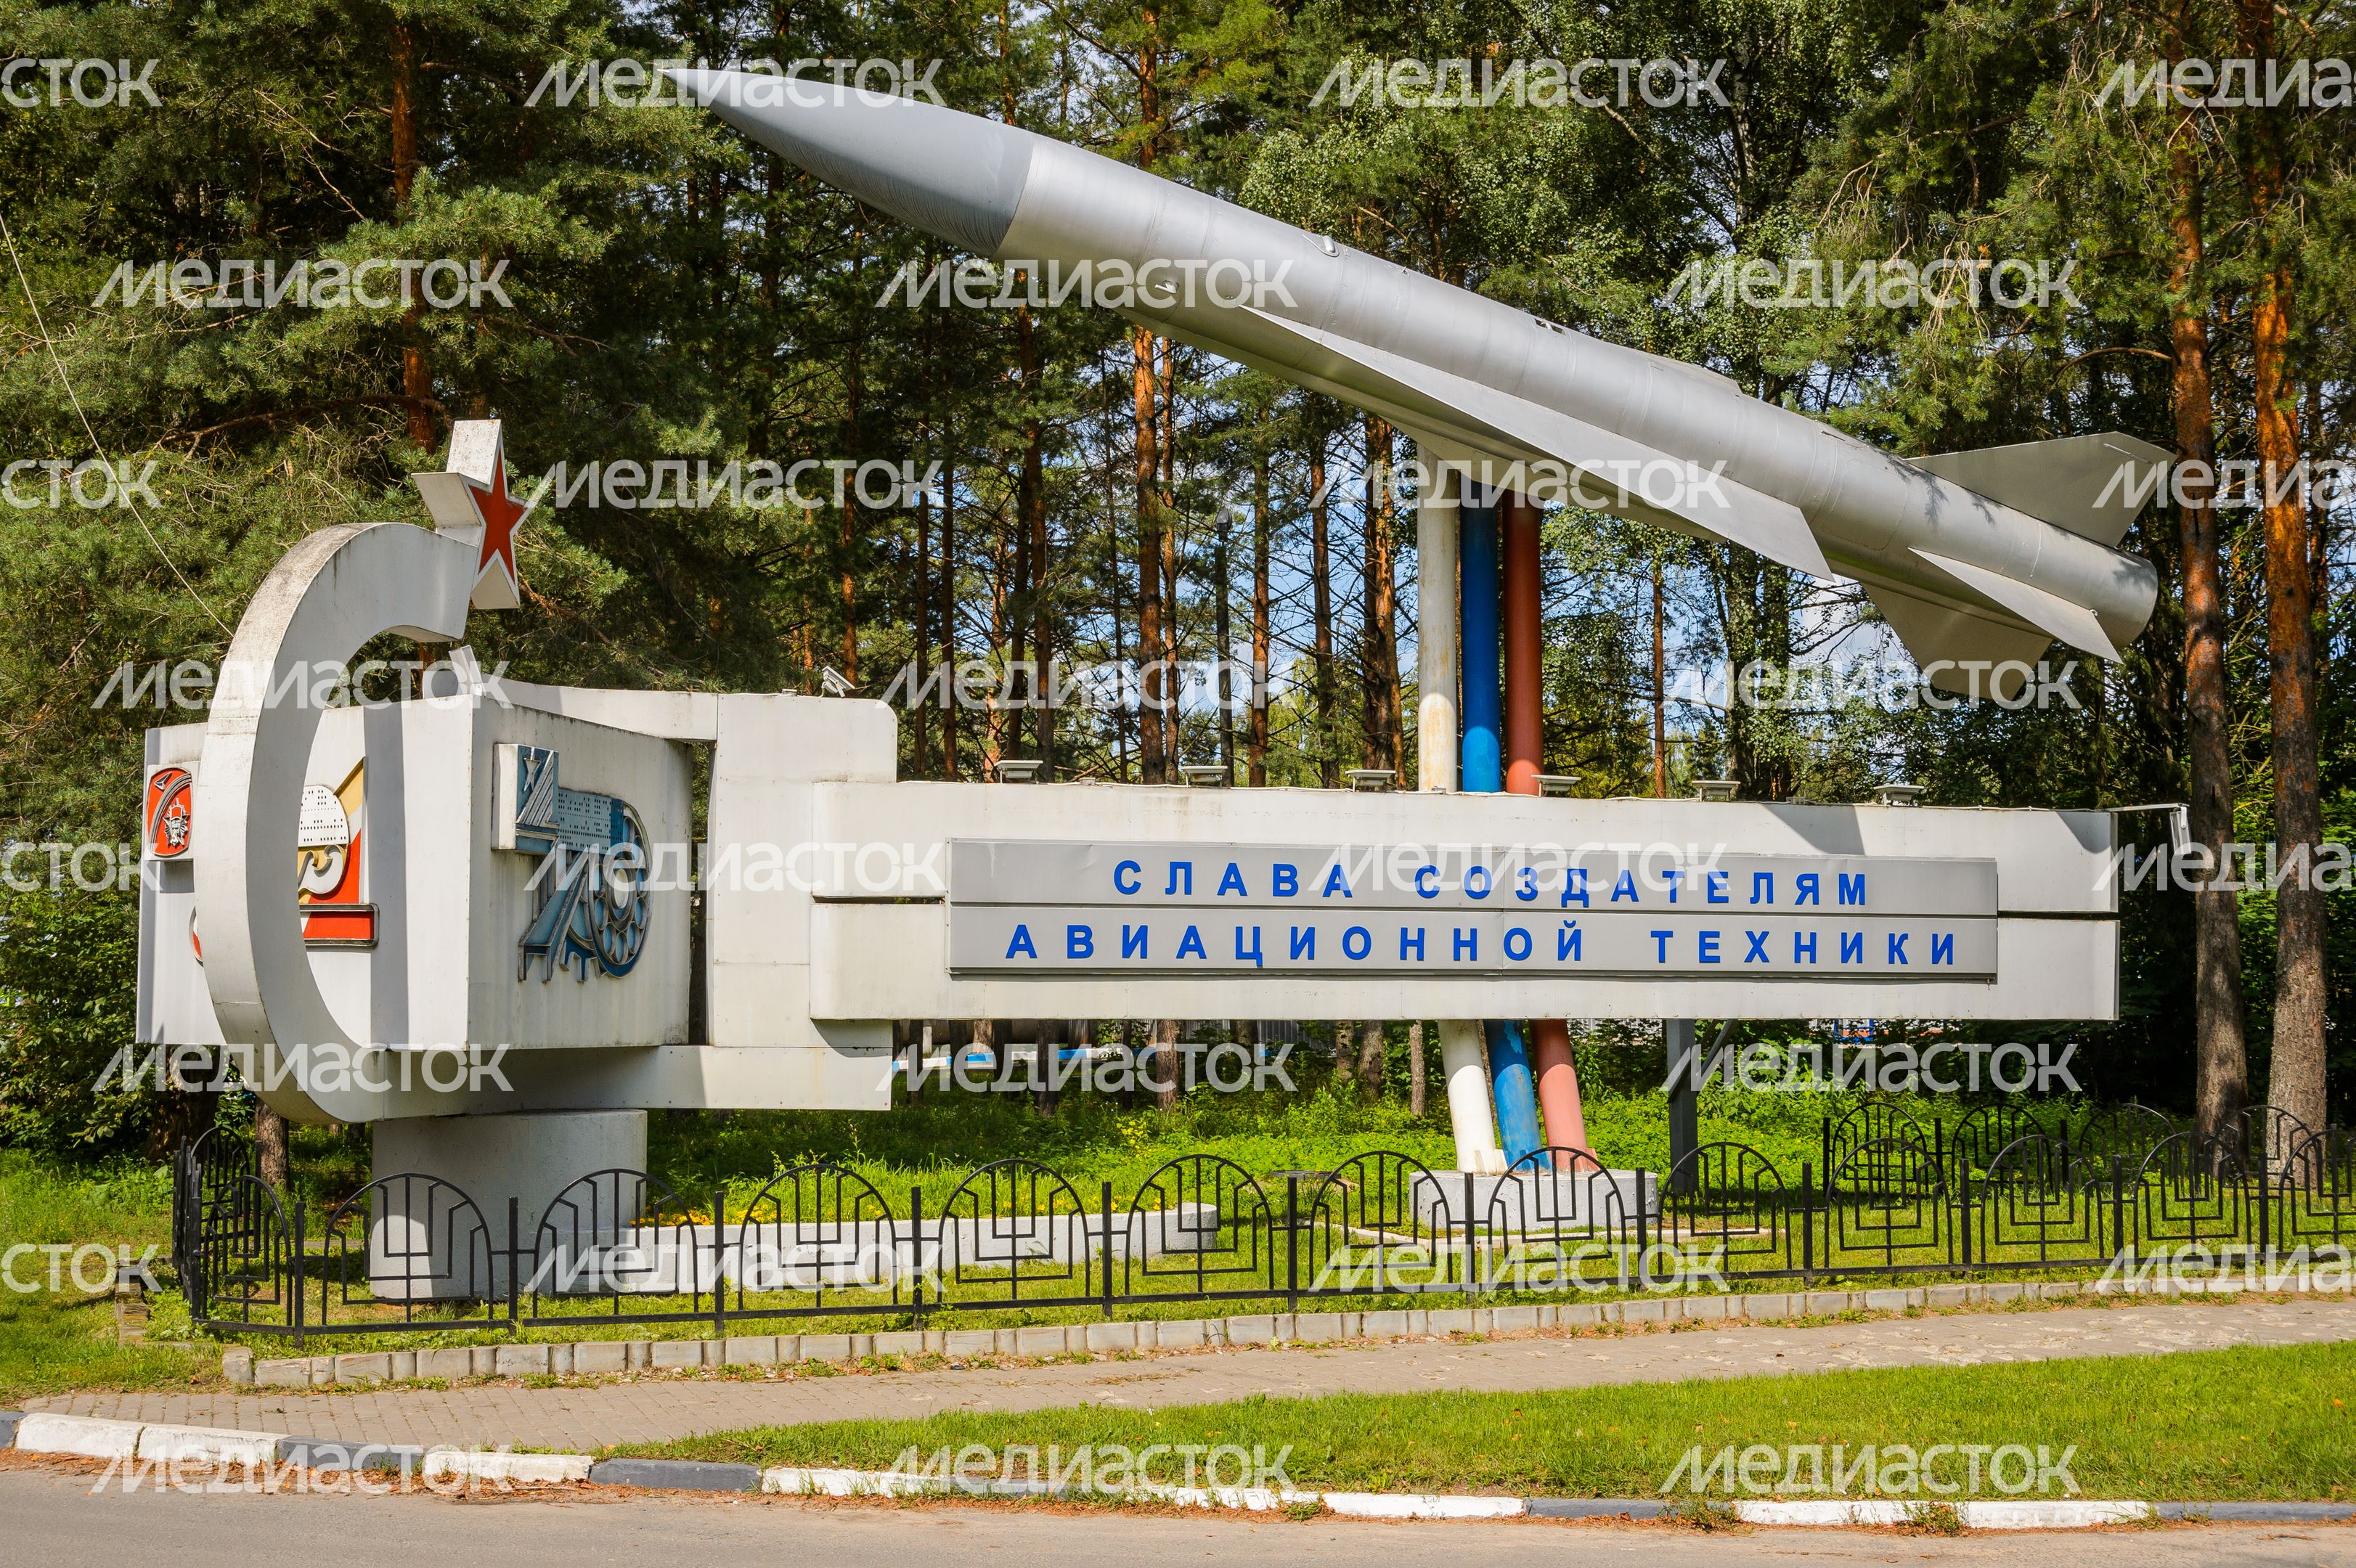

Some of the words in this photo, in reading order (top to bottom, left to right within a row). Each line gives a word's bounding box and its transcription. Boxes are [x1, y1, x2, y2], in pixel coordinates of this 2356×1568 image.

[1114, 860, 1353, 897] СЛАВА
[1414, 865, 1866, 907] СОЗДАТЕЛЯМ
[1006, 920, 1582, 968] АВИАЦИОННОЙ
[1650, 930, 1954, 965] ТЕХНИКИ
